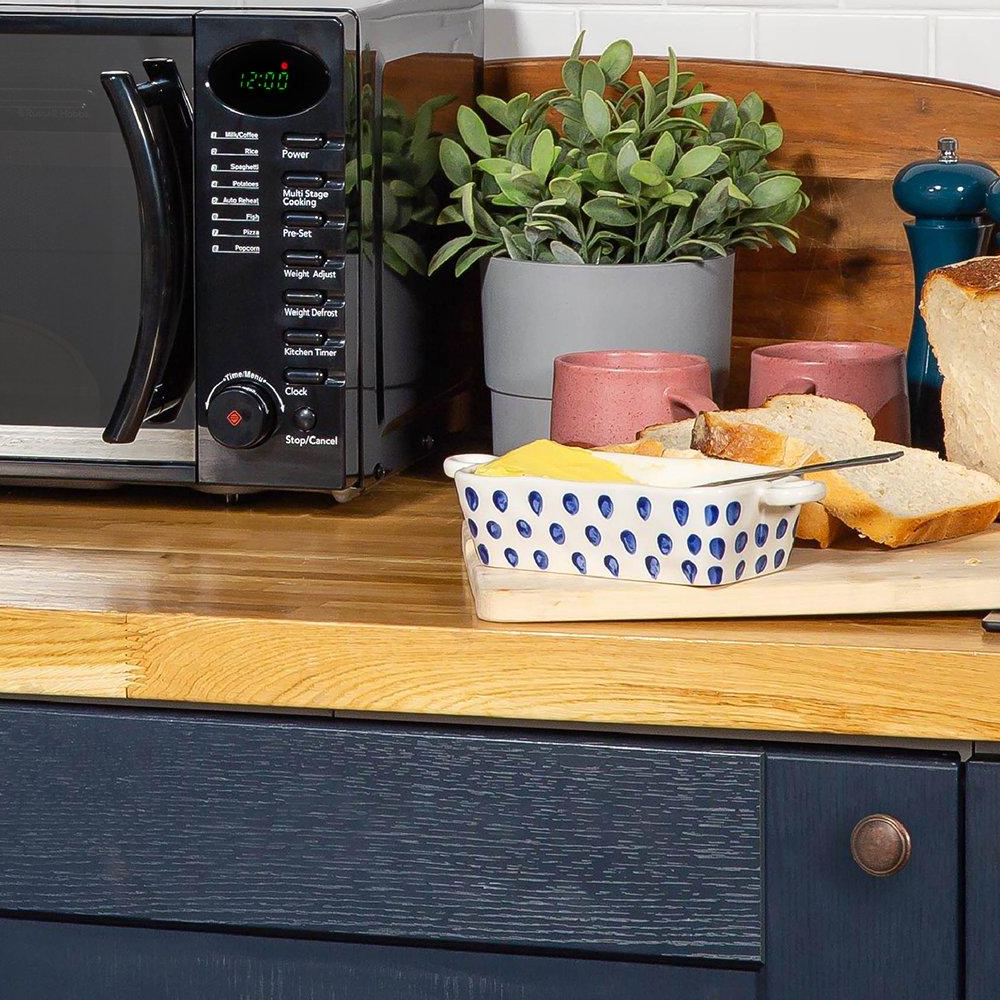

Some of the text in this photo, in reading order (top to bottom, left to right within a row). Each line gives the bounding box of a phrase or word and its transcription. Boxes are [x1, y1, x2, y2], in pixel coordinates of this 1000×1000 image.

[240, 71, 289, 90] 12:00
[282, 149, 310, 159] Power
[283, 189, 329, 200] Multi Stage
[283, 198, 317, 208] Cooking
[283, 229, 312, 238] Pre-Set
[234, 244, 260, 252] Popcorn
[284, 270, 336, 280] Weight Adjust
[285, 308, 338, 318] Weight Defrost
[284, 348, 337, 357] Kitchen Timer
[224, 370, 264, 382] Time/Menu
[285, 387, 308, 396] Clock
[285, 435, 338, 446] Stop/Cancel
